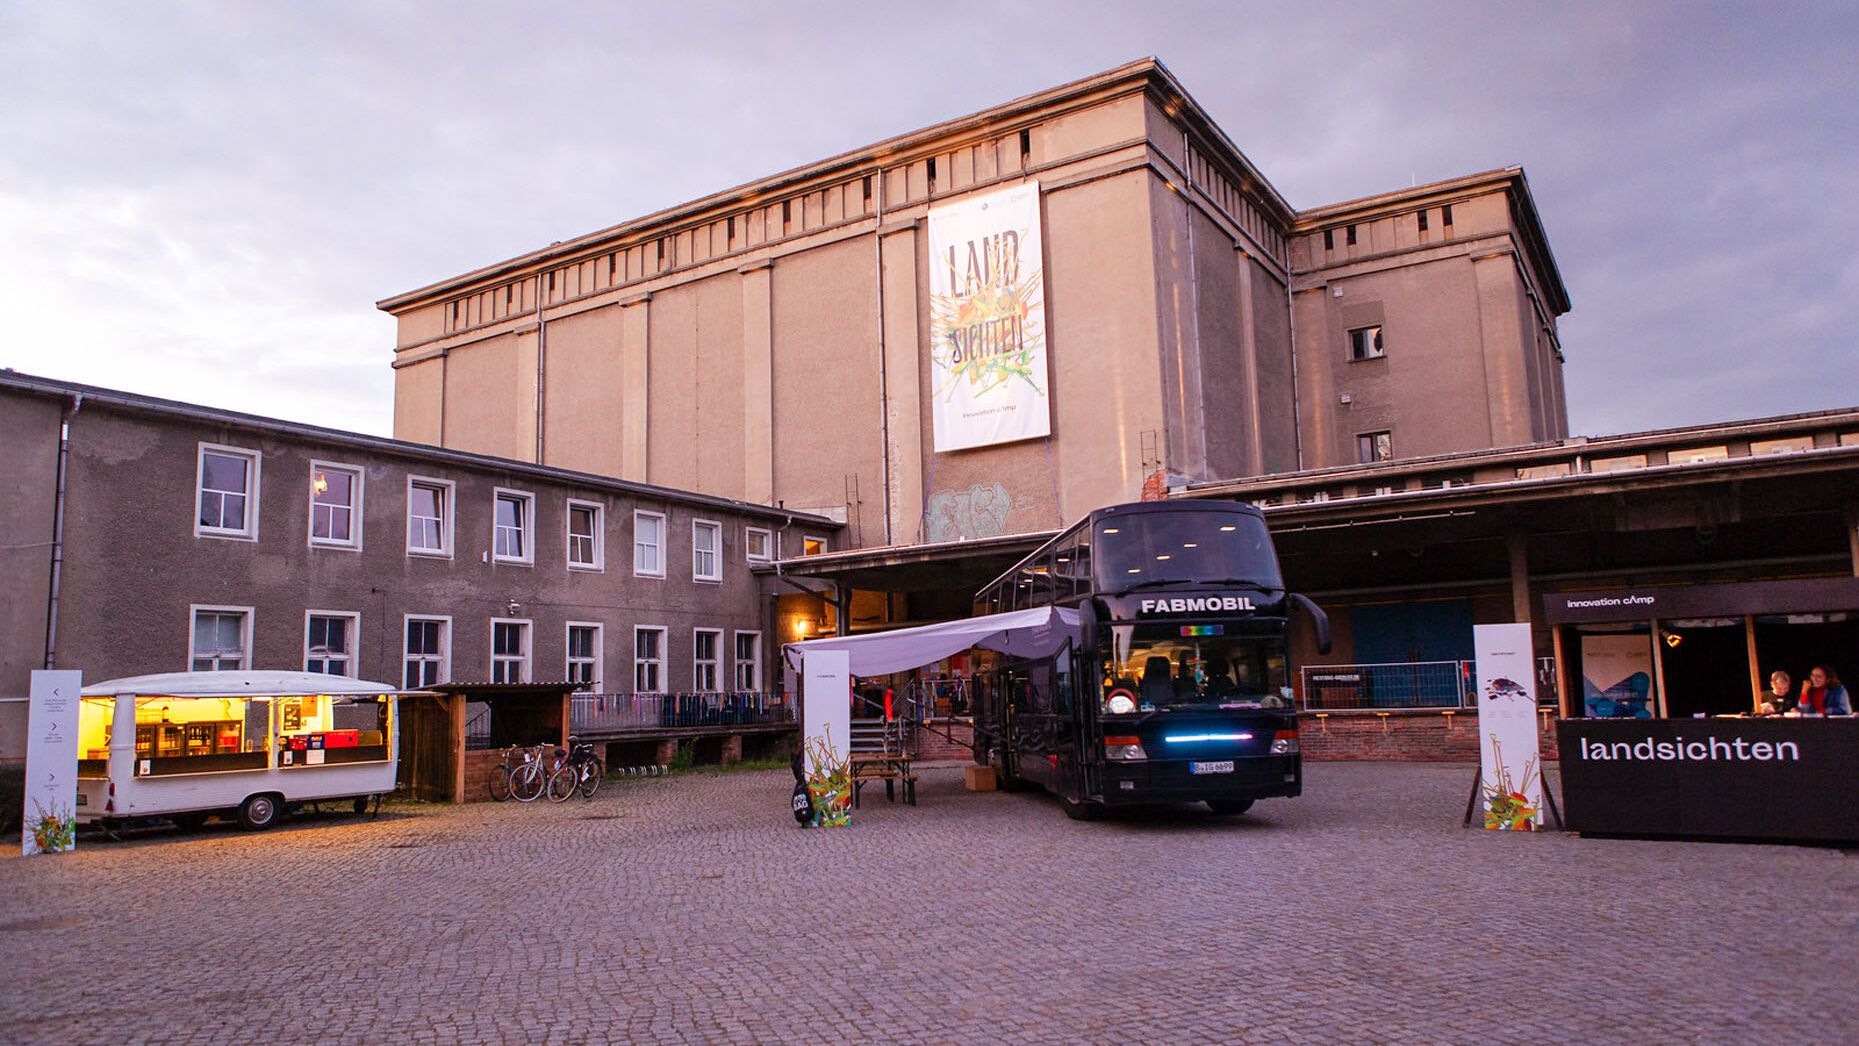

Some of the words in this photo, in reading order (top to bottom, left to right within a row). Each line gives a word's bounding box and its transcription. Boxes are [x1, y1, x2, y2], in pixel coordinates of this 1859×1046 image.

[949, 229, 1020, 298] LAND
[952, 313, 1023, 364] SICHTEN
[1141, 597, 1256, 613] FABMOBIL
[1580, 736, 1800, 761] landsichten
